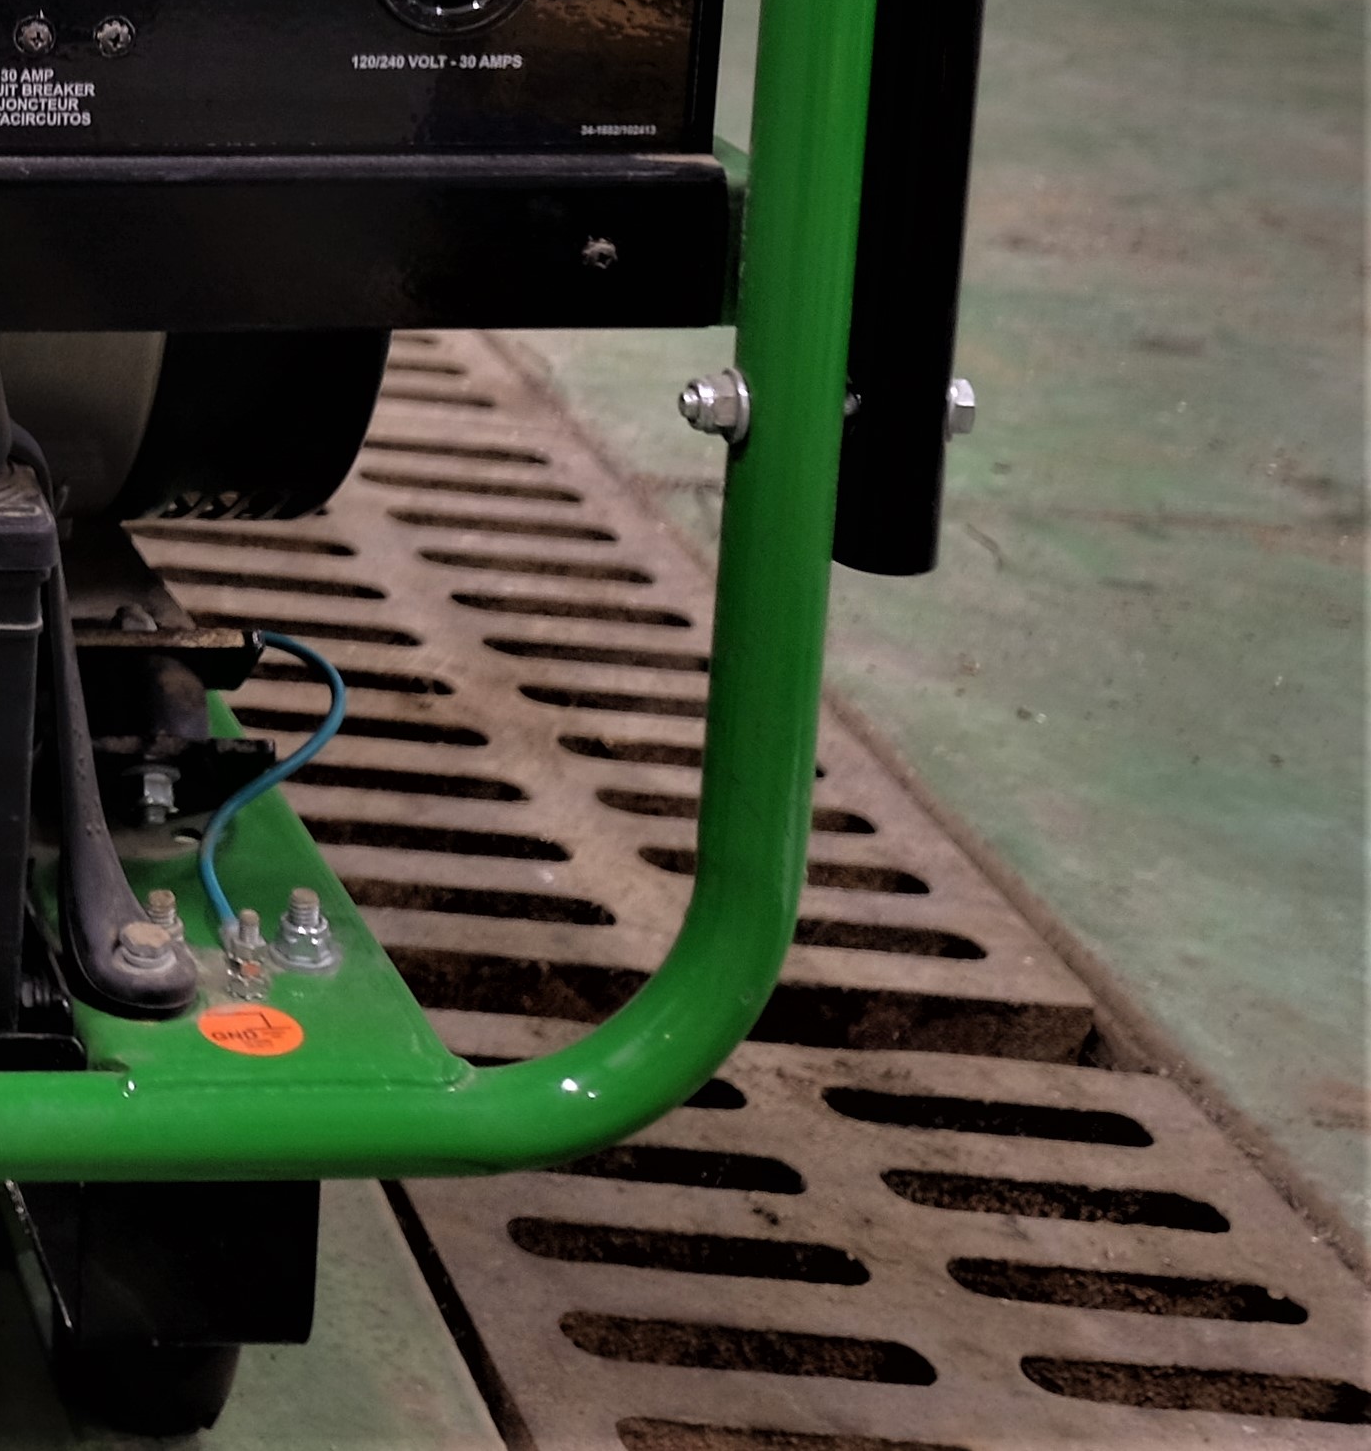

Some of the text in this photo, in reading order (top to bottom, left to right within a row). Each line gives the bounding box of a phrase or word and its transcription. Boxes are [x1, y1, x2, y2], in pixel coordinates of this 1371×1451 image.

[351, 54, 406, 69] 120/240
[407, 54, 448, 69] VOLT
[459, 54, 477, 69] 30
[478, 54, 523, 69] AMPS
[0, 68, 54, 83] 30 AMP
[21, 83, 95, 97] BREAKER
